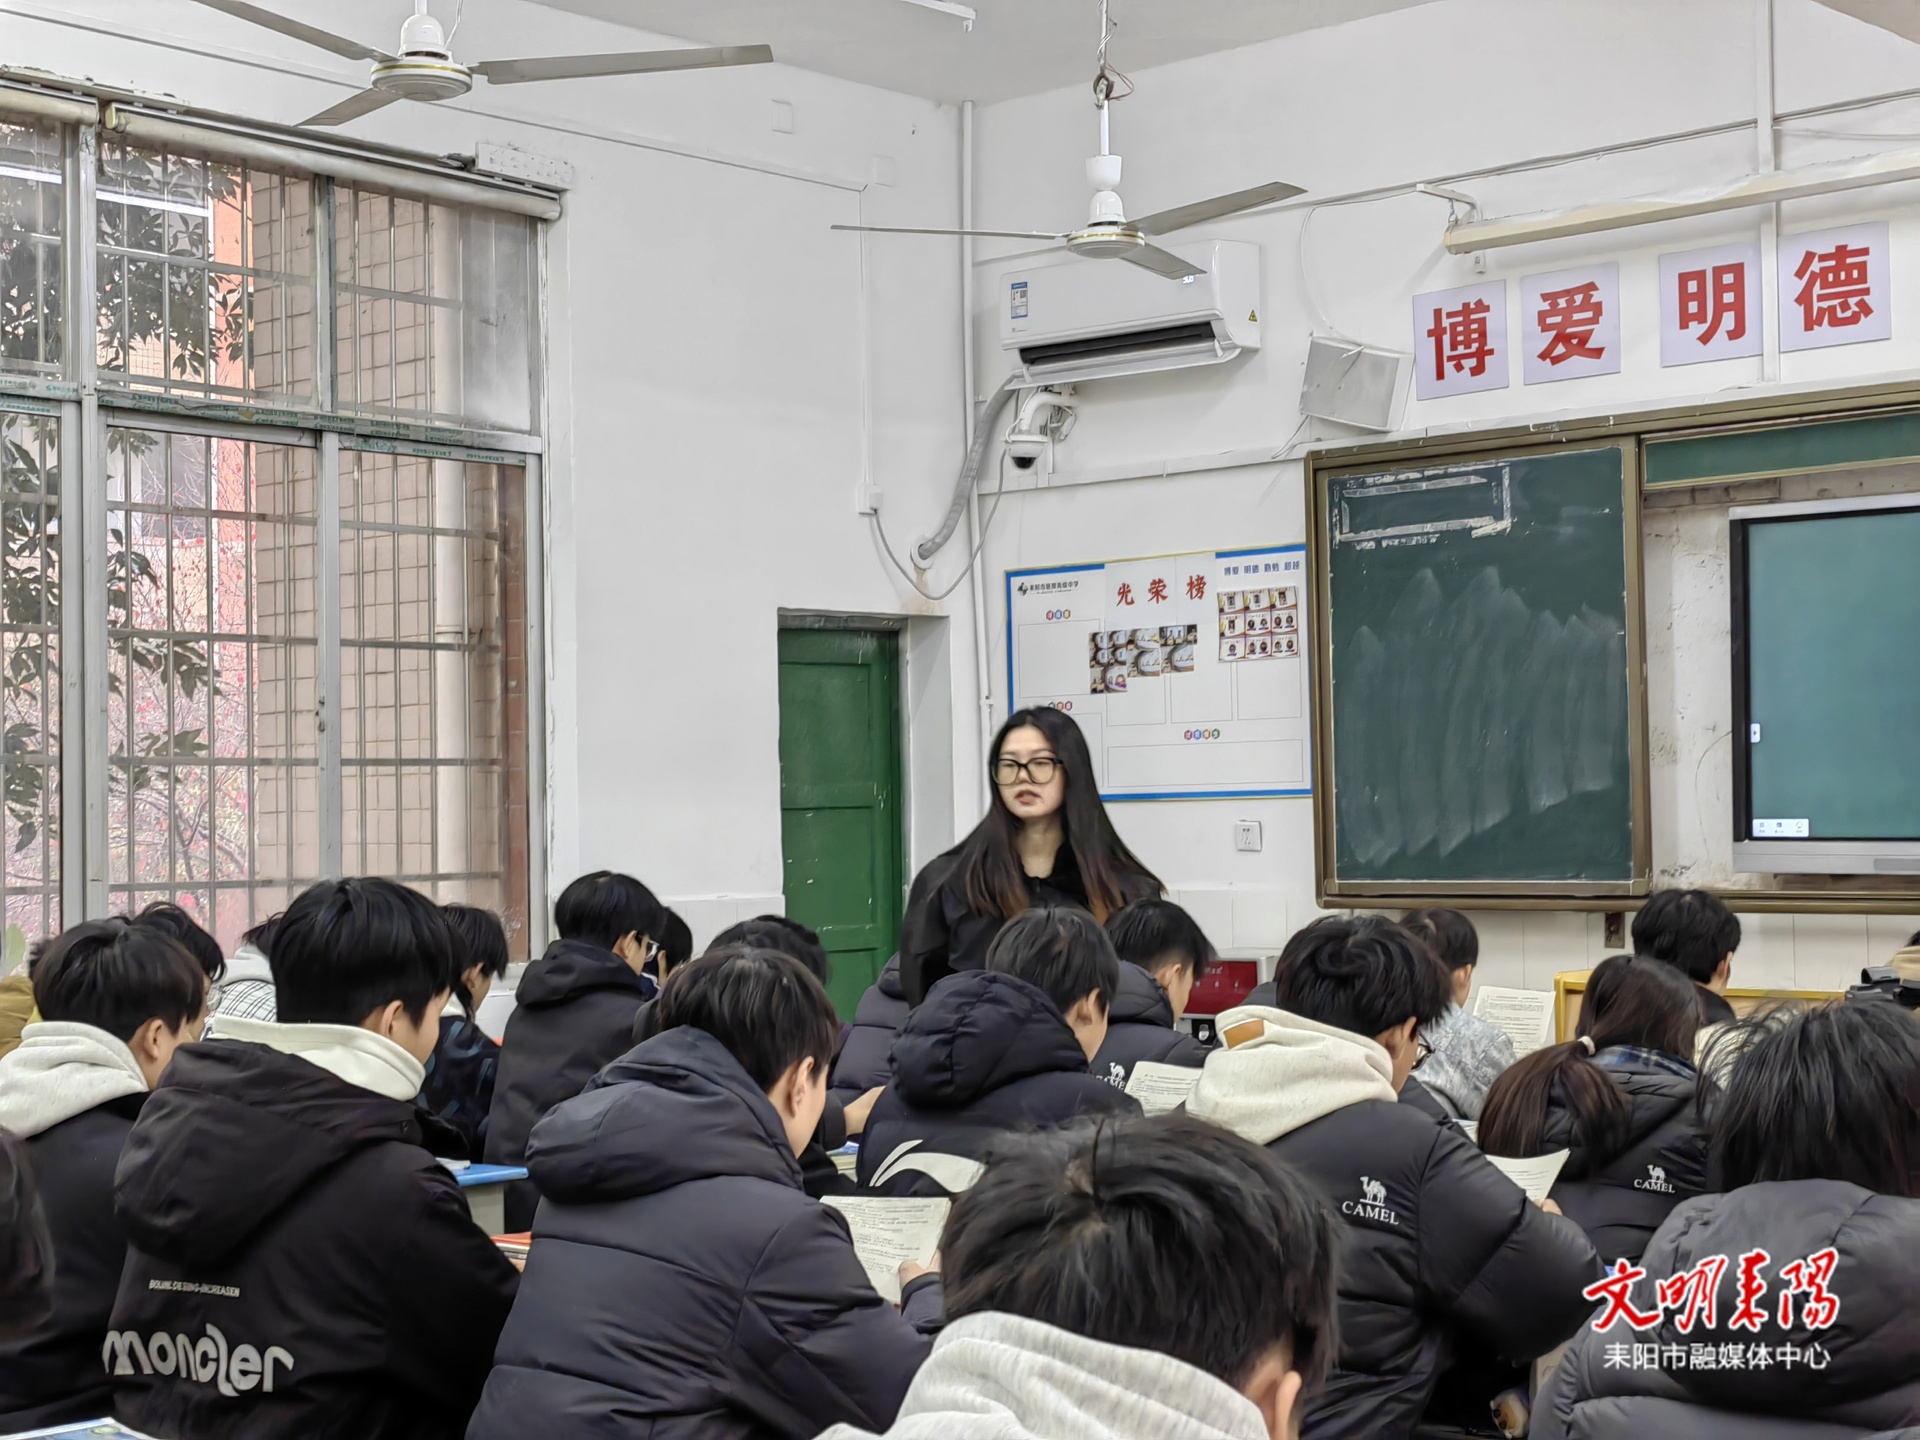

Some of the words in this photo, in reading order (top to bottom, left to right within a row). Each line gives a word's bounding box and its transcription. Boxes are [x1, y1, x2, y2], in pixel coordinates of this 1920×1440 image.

[1427, 281, 1606, 381] 博爱
[1678, 244, 1874, 345] 明德
[1116, 574, 1207, 607] 光荣榜
[1634, 1178, 1675, 1193] CAMEL
[1342, 1201, 1399, 1226] CAMEL
